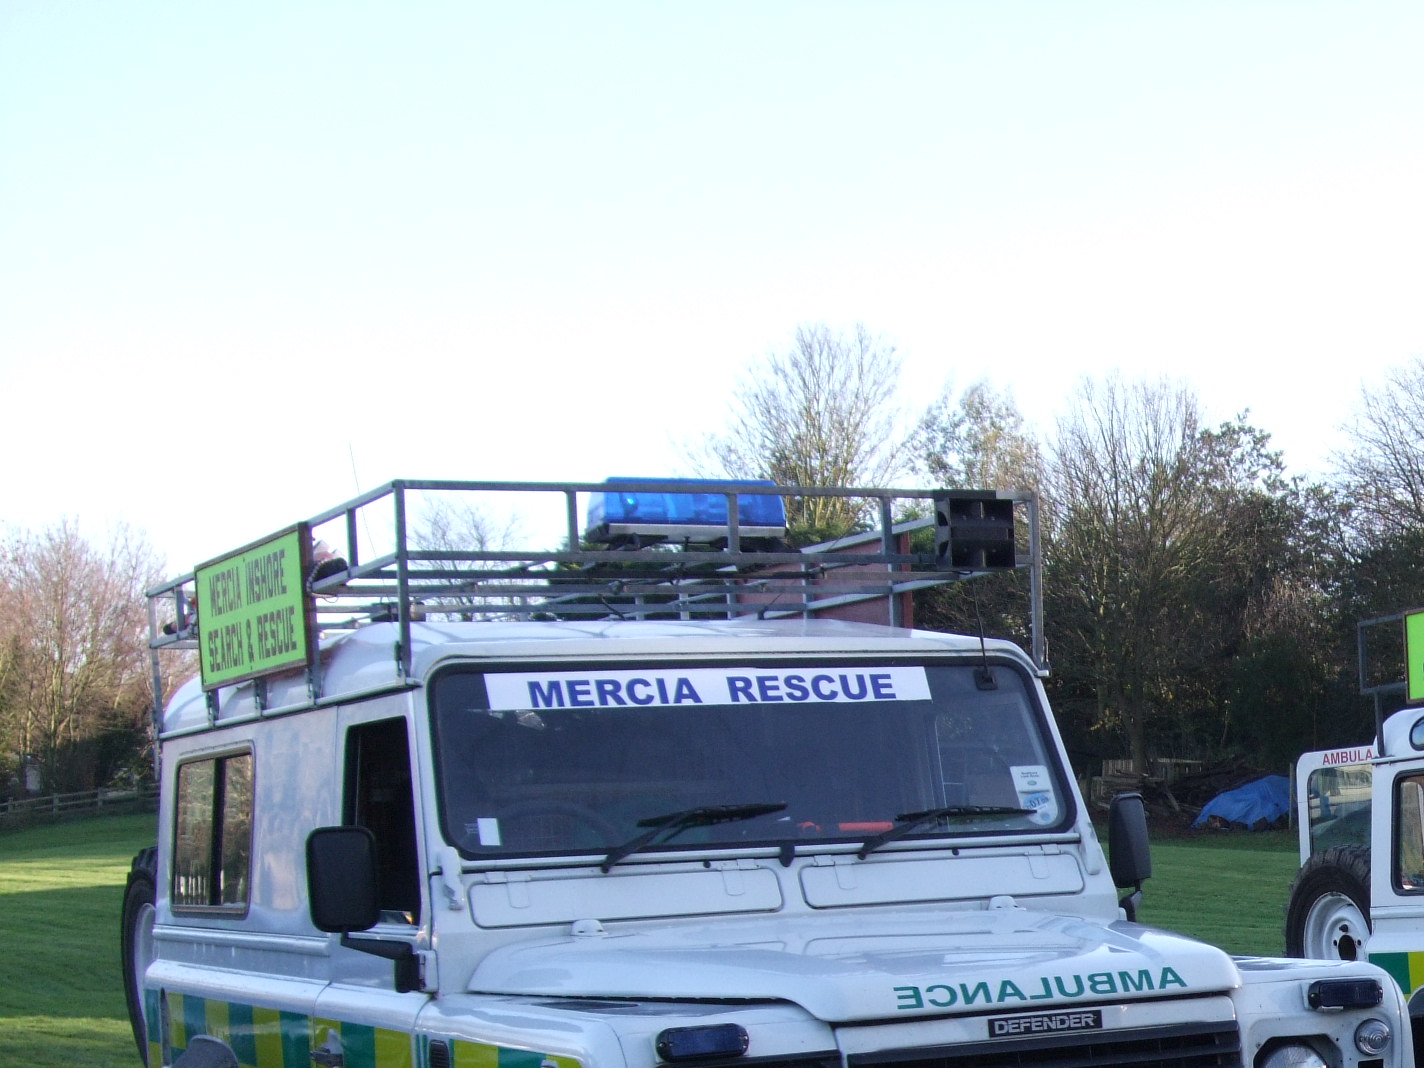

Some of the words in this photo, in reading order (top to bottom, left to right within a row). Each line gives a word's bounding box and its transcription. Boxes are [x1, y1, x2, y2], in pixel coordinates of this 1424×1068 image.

[209, 566, 242, 618] MERCIA
[245, 548, 287, 606] INSHORE
[208, 621, 244, 672] SEARCH
[246, 618, 255, 664] &
[256, 604, 298, 660] RESCUE
[527, 677, 703, 708] MERCIA
[726, 673, 897, 702] RESCUE
[994, 1013, 1096, 1035] DEFENDER
